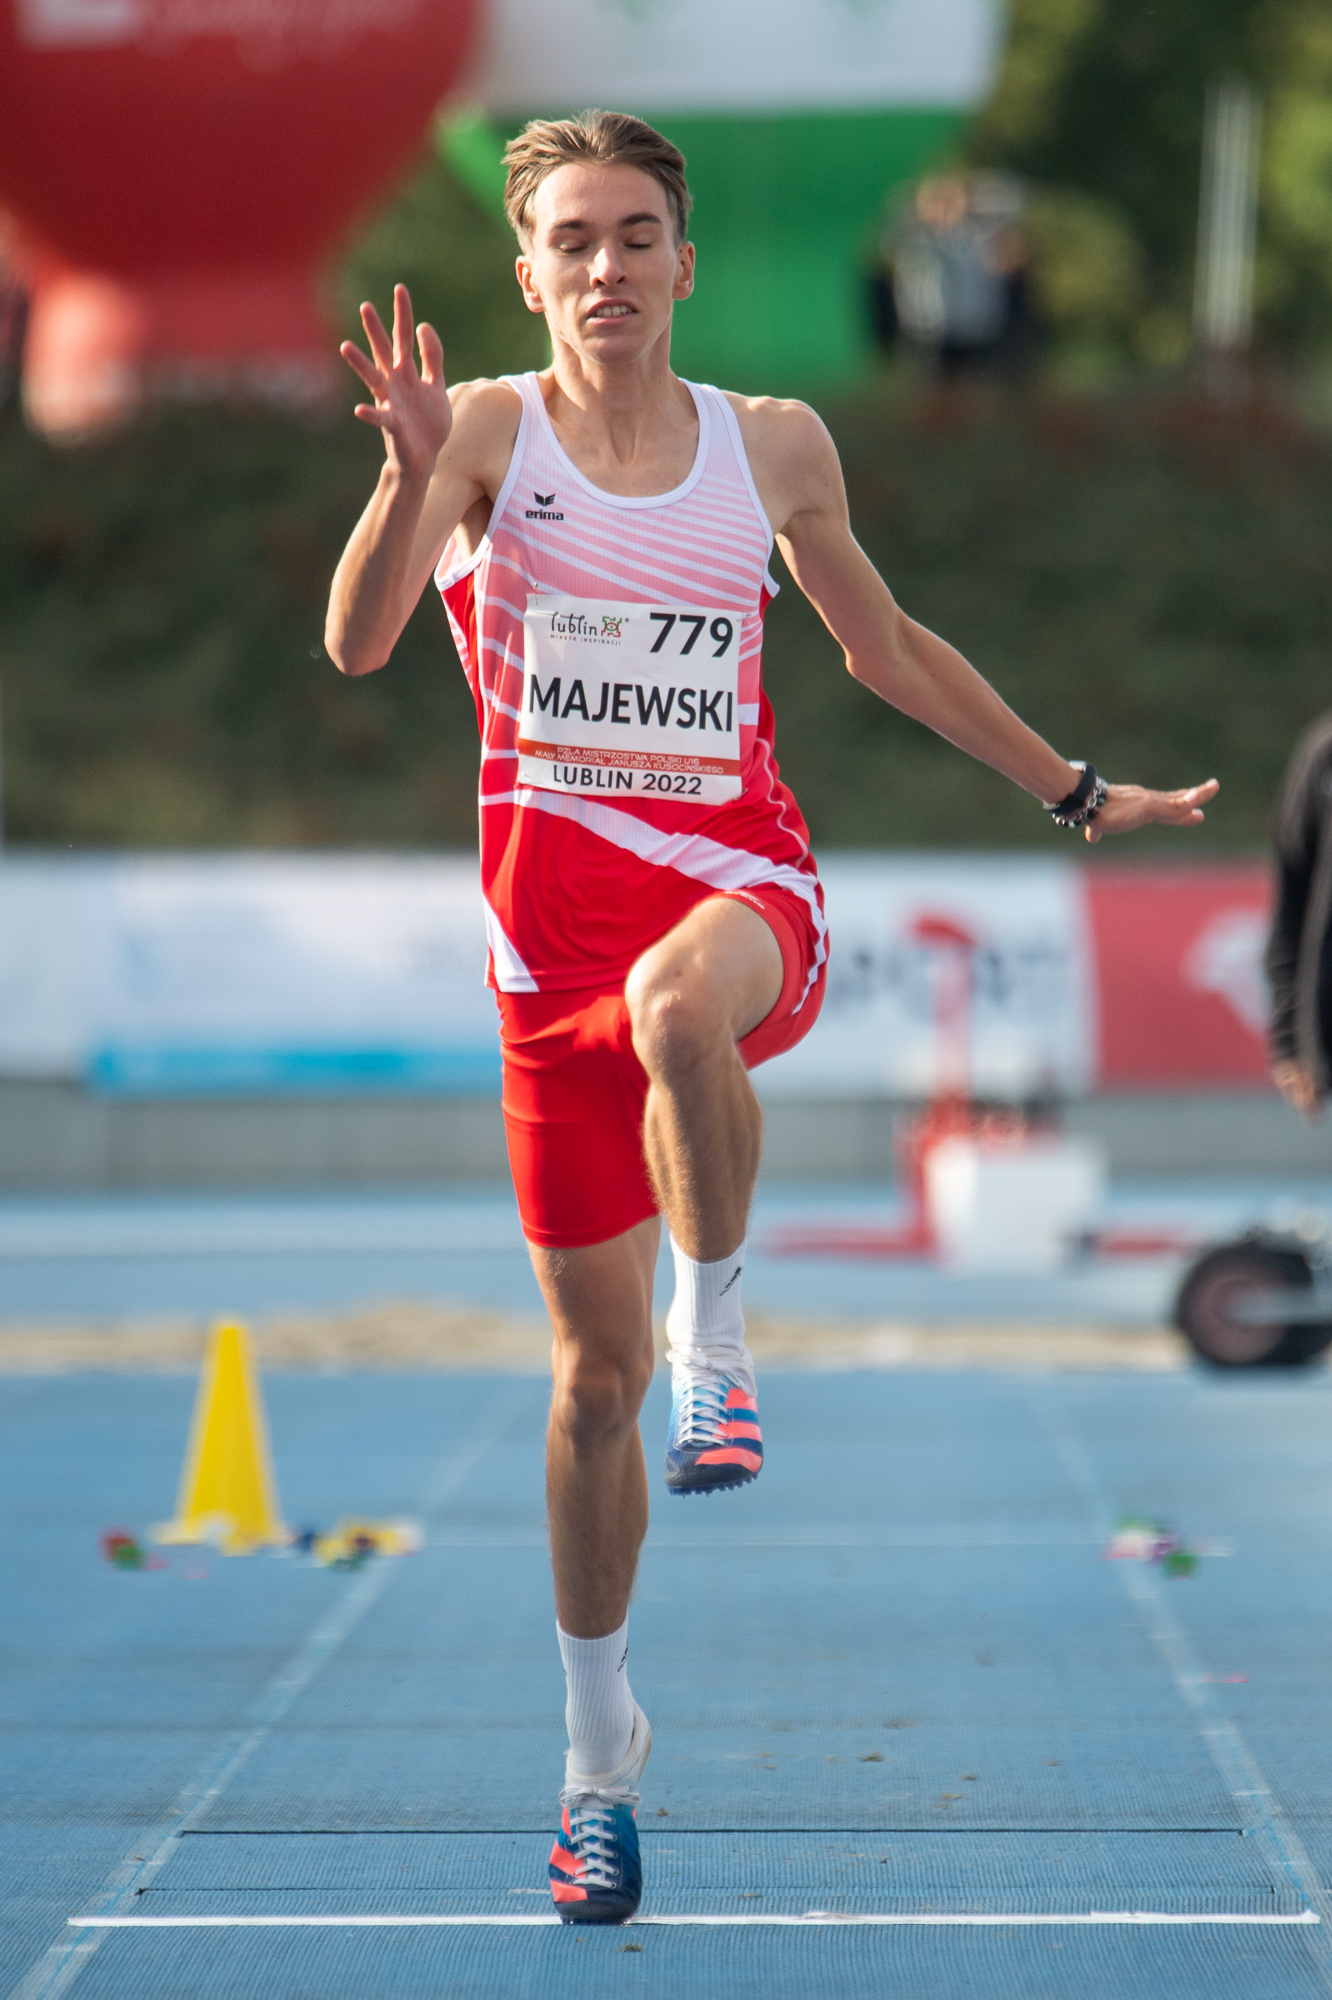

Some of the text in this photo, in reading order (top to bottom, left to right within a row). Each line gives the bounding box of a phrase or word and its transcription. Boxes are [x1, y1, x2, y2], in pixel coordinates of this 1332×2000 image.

[525, 509, 564, 521] erima
[551, 611, 598, 636] lublin
[550, 634, 621, 646] MIASTO INSPIRACJI
[650, 612, 733, 658] 779
[529, 674, 733, 732] MAJEWSKI
[556, 746, 700, 766] PZLA MISTRZOSTWA POLSKI U16
[607, 759, 652, 769] JANUSZA
[553, 764, 702, 796] LUBLIN 2022
